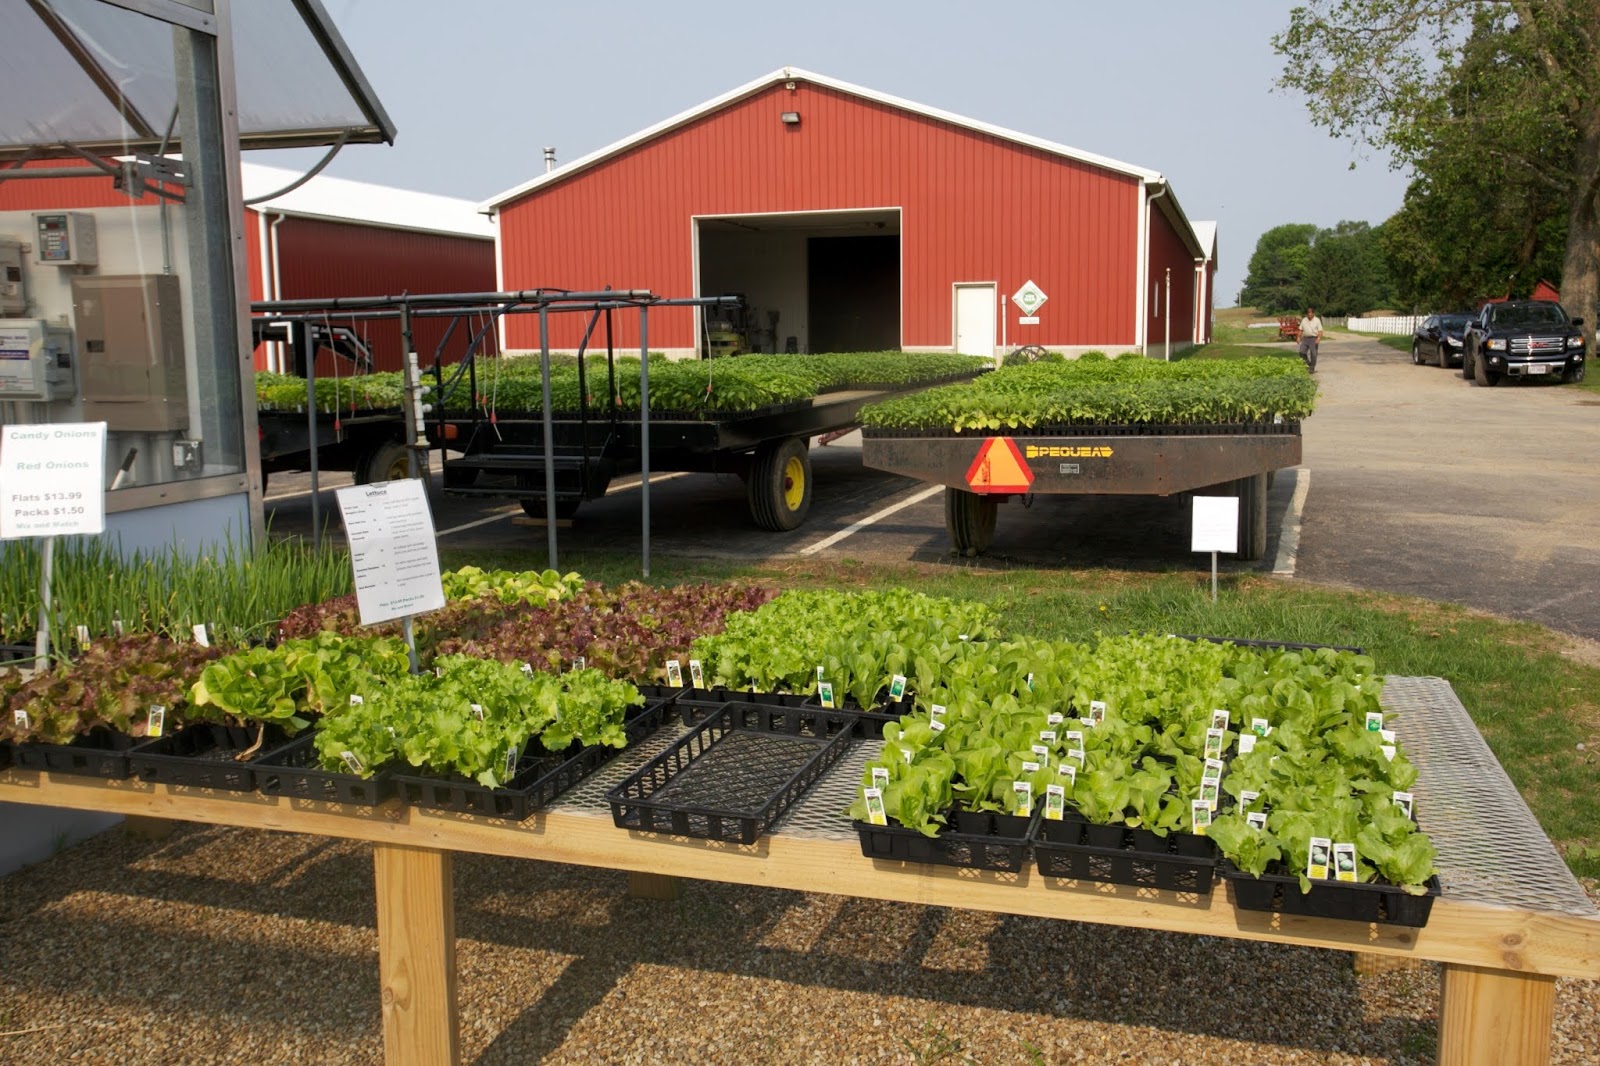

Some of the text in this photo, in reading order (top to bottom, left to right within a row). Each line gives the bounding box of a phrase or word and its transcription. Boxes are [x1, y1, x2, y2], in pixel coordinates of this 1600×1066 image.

[10, 430, 97, 440] Candy Onions
[16, 461, 90, 470] Red Onions
[12, 492, 83, 502] Flats $13.99
[14, 506, 85, 517] Packs $1.50
